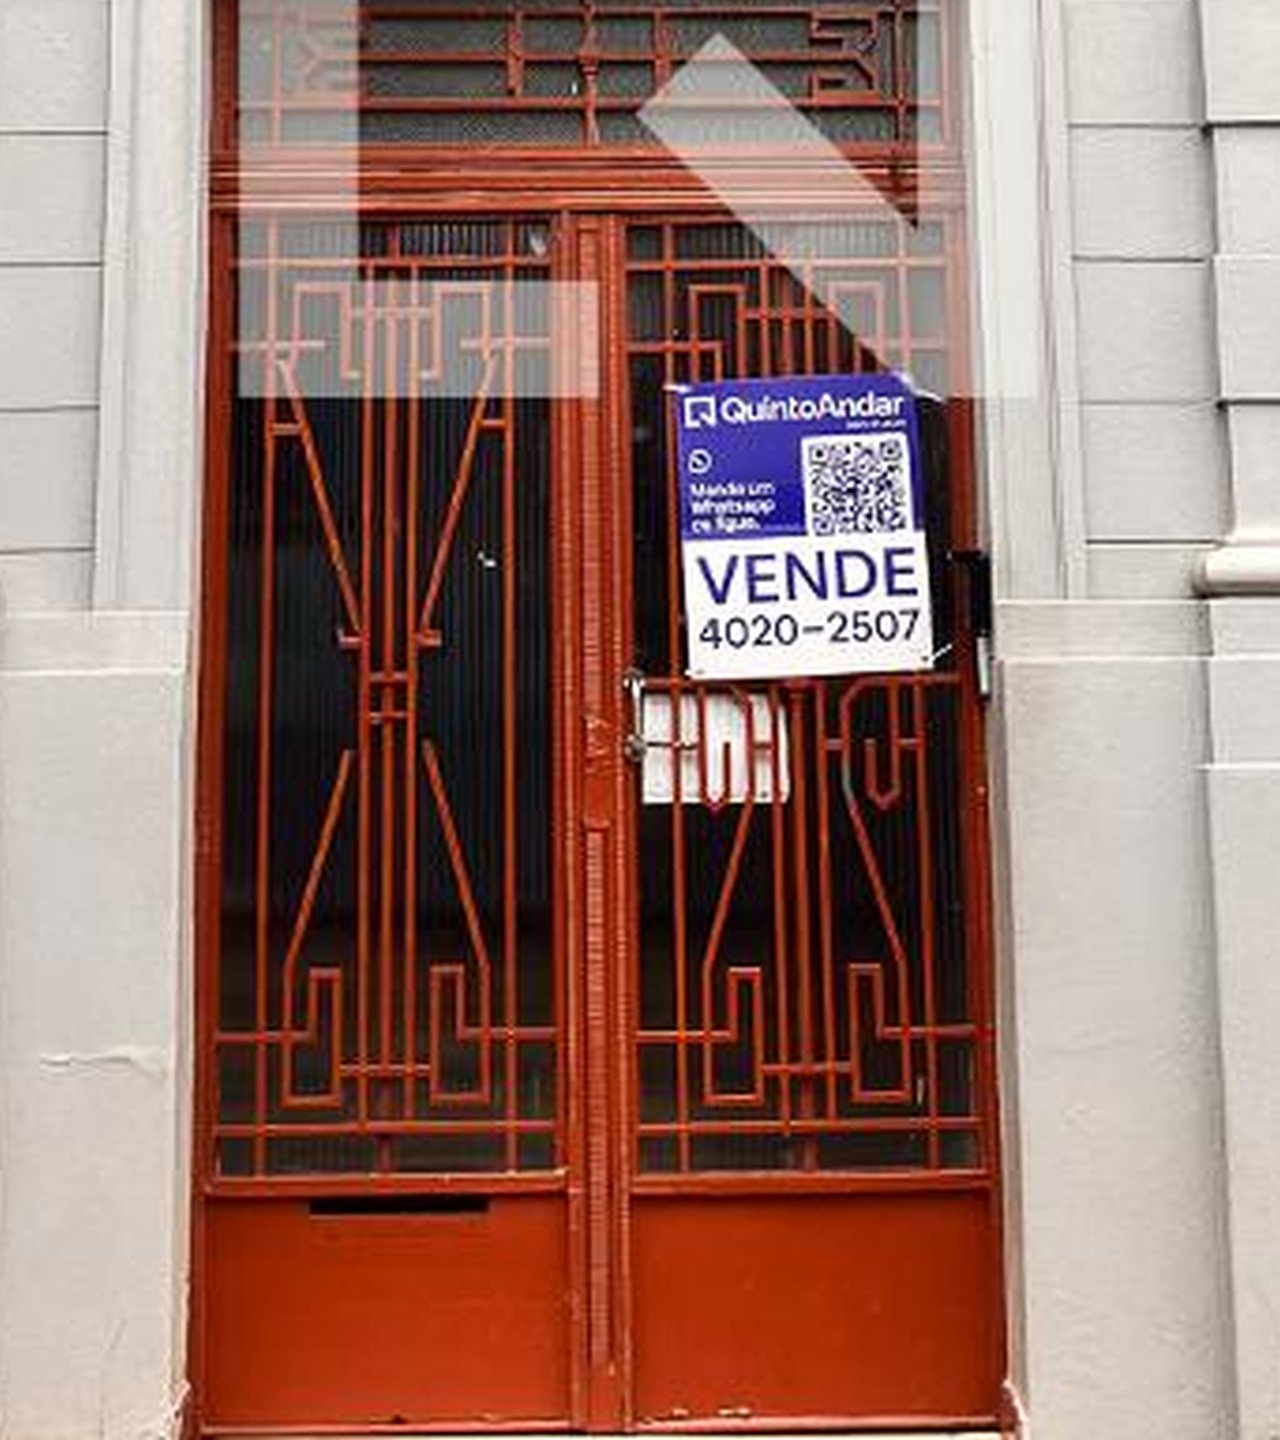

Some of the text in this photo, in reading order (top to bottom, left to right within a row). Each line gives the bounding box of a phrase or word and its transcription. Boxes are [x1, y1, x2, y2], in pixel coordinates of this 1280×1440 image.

[721, 390, 904, 424] QuintoAndar
[697, 547, 918, 604] VENDE
[699, 609, 919, 649] 4020-2507
